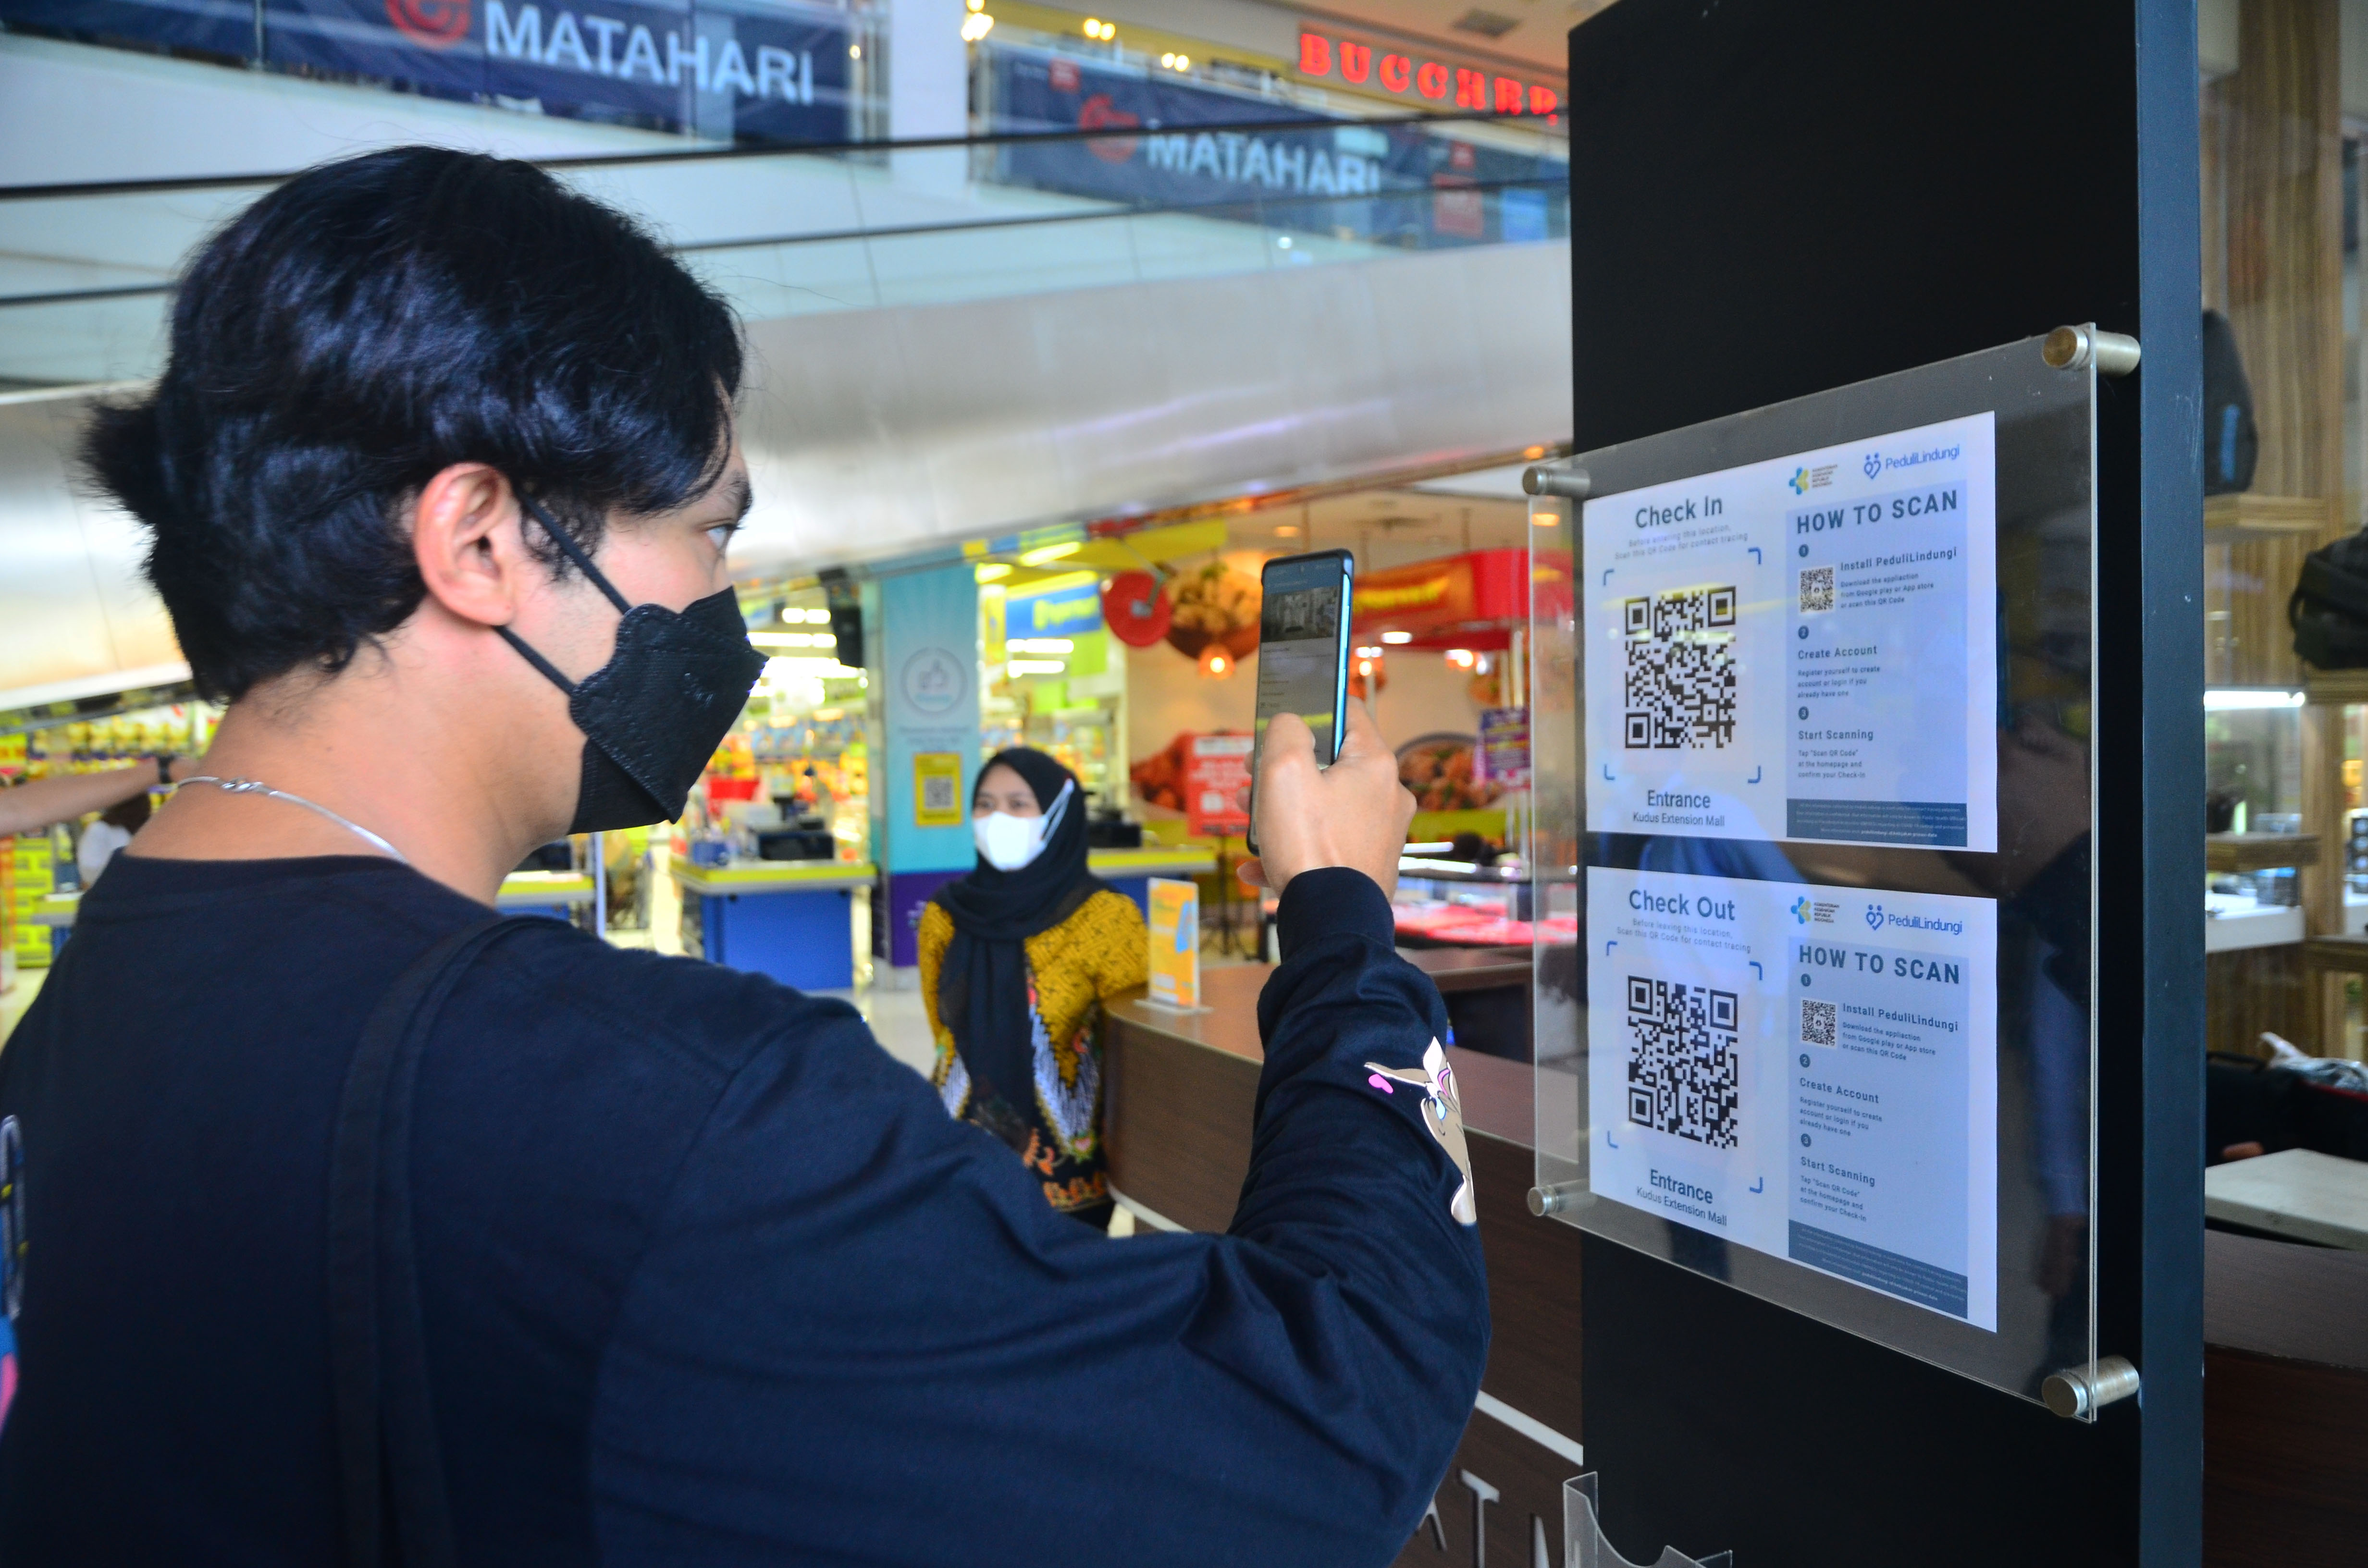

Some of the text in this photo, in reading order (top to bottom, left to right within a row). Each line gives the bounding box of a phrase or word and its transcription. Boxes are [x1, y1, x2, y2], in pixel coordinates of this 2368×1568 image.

[485, 0, 814, 105] MATAHARI
[1147, 120, 1381, 195] MATAHARI
[1886, 444, 1960, 469] PeduliLindungi
[1636, 495, 1722, 528] Check In
[1797, 489, 1957, 534] HOW TO SCAN
[1659, 544, 1676, 552] Code
[1678, 541, 1688, 549] for
[1691, 537, 1718, 548] contact
[1721, 532, 1748, 543] tracing
[1683, 528, 1696, 538] this
[1841, 547, 1957, 571] Install PeduliLindungi
[1841, 577, 1870, 588] Download
[1872, 576, 1882, 584] the
[1841, 590, 1855, 598] from
[1856, 588, 1878, 598] Google
[1879, 587, 1892, 596] play
[1903, 584, 1915, 593] App
[1864, 598, 1876, 606] this
[1878, 597, 1887, 605] QR
[1888, 596, 1905, 604] Code
[1798, 645, 1877, 660] Create Account
[1798, 669, 1823, 678] Register
[1825, 667, 1850, 676] yourself
[1832, 679, 1847, 687] login
[1798, 690, 1819, 698] already
[1798, 729, 1874, 741] Start Scanning
[1817, 760, 1849, 769] homepage
[1648, 789, 1711, 808] Entrance
[1633, 811, 1725, 826] Kudus Extension Mall
[1629, 890, 1735, 920] Check Out
[1633, 918, 1654, 928] Before
[1684, 926, 1697, 934] this
[1888, 914, 1962, 935] PeduliLindungi
[1617, 926, 1751, 954] Scan this QR Code for contact tracing
[1799, 945, 1959, 984] HOW TO SCAN
[1843, 1003, 1958, 1032] Install PeduliLindungi
[1843, 1022, 1872, 1033] Download
[1874, 1026, 1884, 1034] the
[1843, 1032, 1857, 1041] from
[1859, 1034, 1880, 1045] Google
[1882, 1040, 1894, 1049] play
[1905, 1044, 1917, 1053] App
[1919, 1047, 1936, 1055] store
[1890, 1052, 1907, 1061] Code
[1800, 1078, 1879, 1103] Create Account
[1800, 1096, 1825, 1108] Register
[1827, 1103, 1852, 1115] yourself
[1862, 1112, 1882, 1122] create
[1800, 1108, 1824, 1119] account
[1834, 1115, 1849, 1125] login
[1800, 1118, 1821, 1129] already
[1824, 1124, 1838, 1133] have
[1801, 1156, 1875, 1187] Start Scanning
[1651, 1168, 1713, 1204] Entrance
[1801, 1176, 1811, 1184] Tap
[1831, 1184, 1840, 1192] QR
[1637, 1186, 1727, 1226] Kudus Extension Mall
[1800, 1197, 1823, 1208] confirm
[1825, 1204, 1838, 1212] your
[1819, 1191, 1850, 1206] homepage
